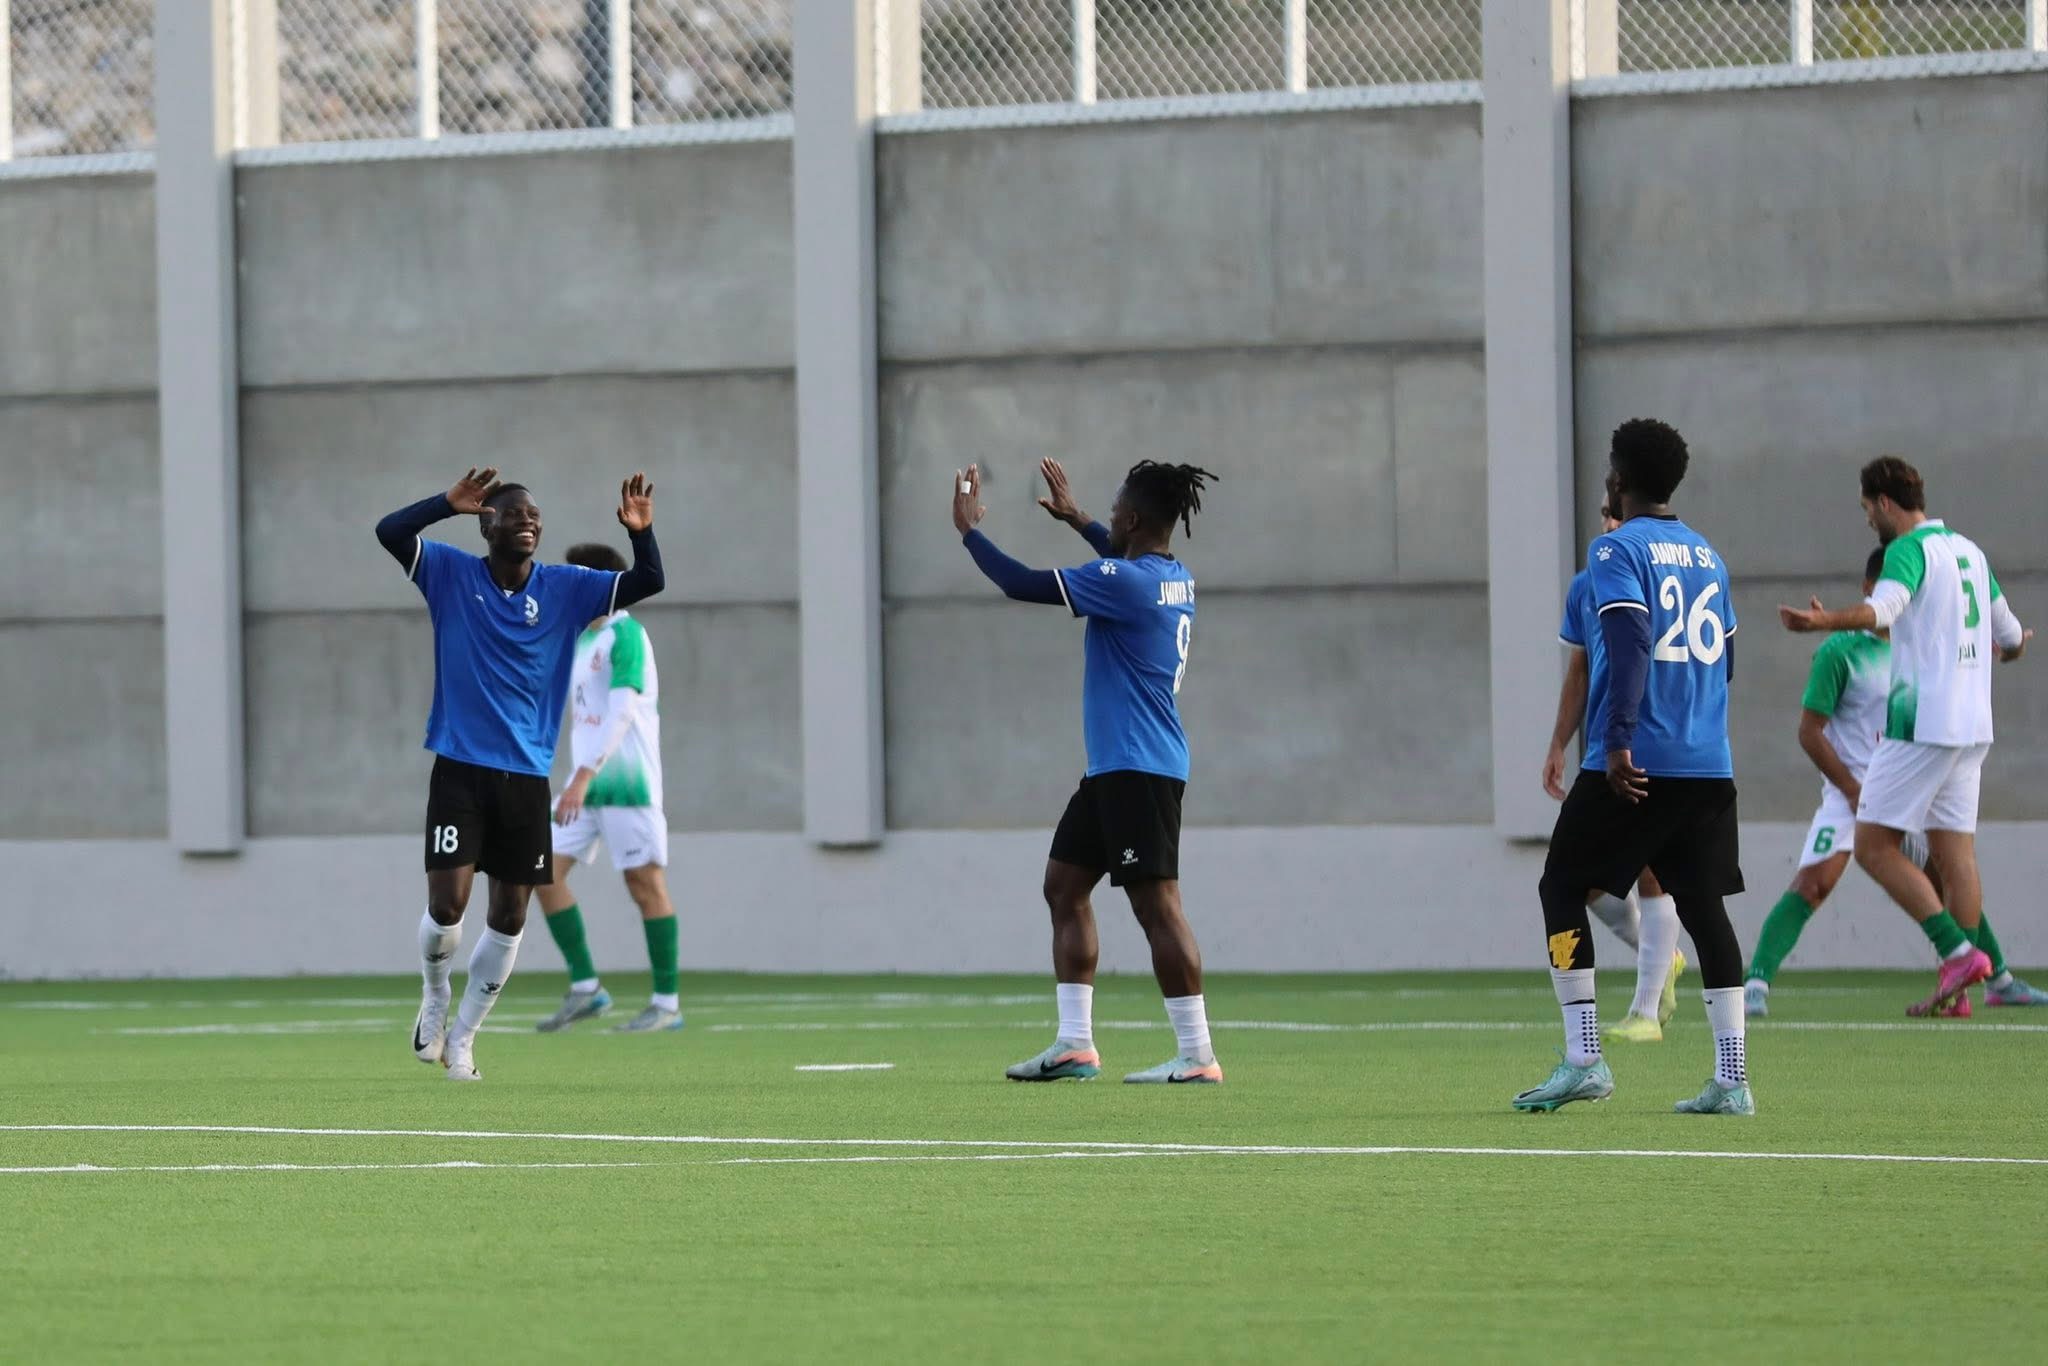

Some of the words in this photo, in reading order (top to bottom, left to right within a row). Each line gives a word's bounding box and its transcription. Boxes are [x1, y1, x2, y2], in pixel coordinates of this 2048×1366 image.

[1695, 546, 1716, 570] SC
[1187, 579, 1195, 604] S
[1956, 555, 1981, 629] 5
[1654, 575, 1725, 666] 26
[1172, 613, 1190, 694] 9
[434, 825, 459, 854] 18
[1813, 826, 1836, 854] 6
